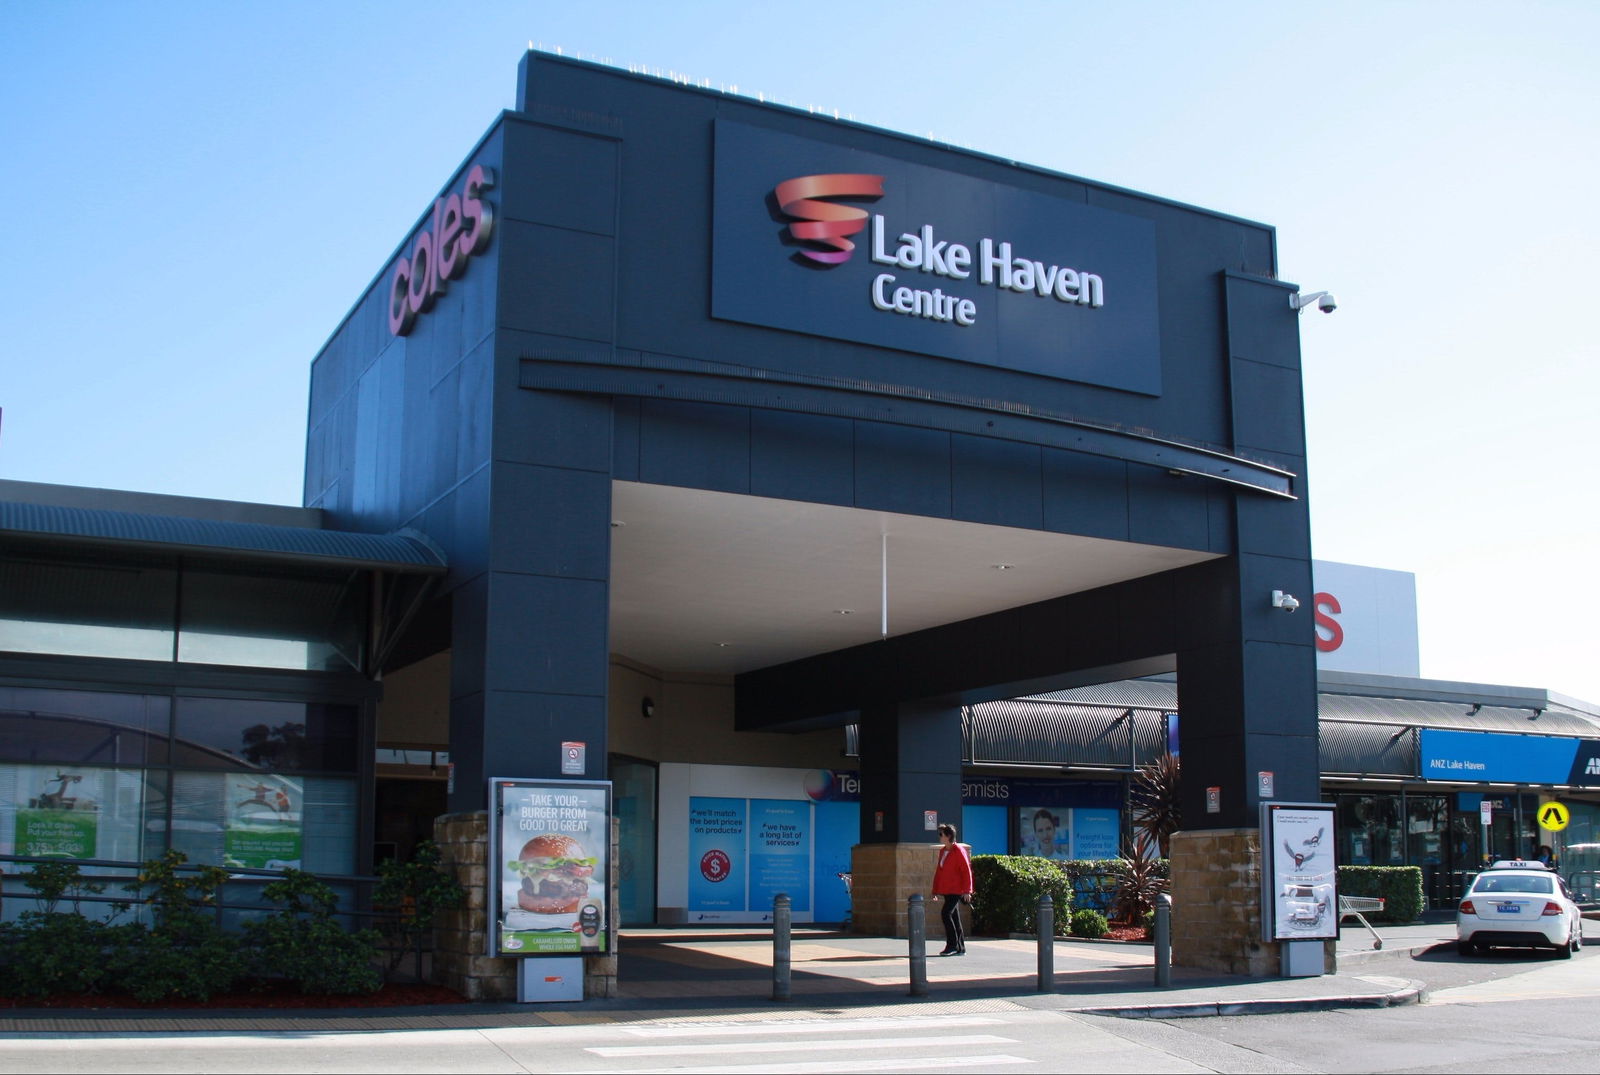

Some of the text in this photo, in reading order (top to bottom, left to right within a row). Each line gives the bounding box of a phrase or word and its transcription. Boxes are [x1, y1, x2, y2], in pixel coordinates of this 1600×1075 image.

[389, 164, 494, 336] coles
[872, 214, 1104, 307] Lake Haven
[872, 273, 976, 325] Centre
[1430, 759, 1485, 771] ANZ Lake Haven
[531, 794, 578, 807] TAKE YOUR
[521, 807, 586, 819] BURGER FROM
[519, 819, 588, 832] GOOD TO GREAT
[703, 818, 719, 826] best
[720, 819, 743, 828] prices
[779, 823, 796, 831] have
[765, 831, 781, 840] long
[782, 831, 793, 839] list
[794, 831, 802, 839] of
[711, 858, 721, 876] $
